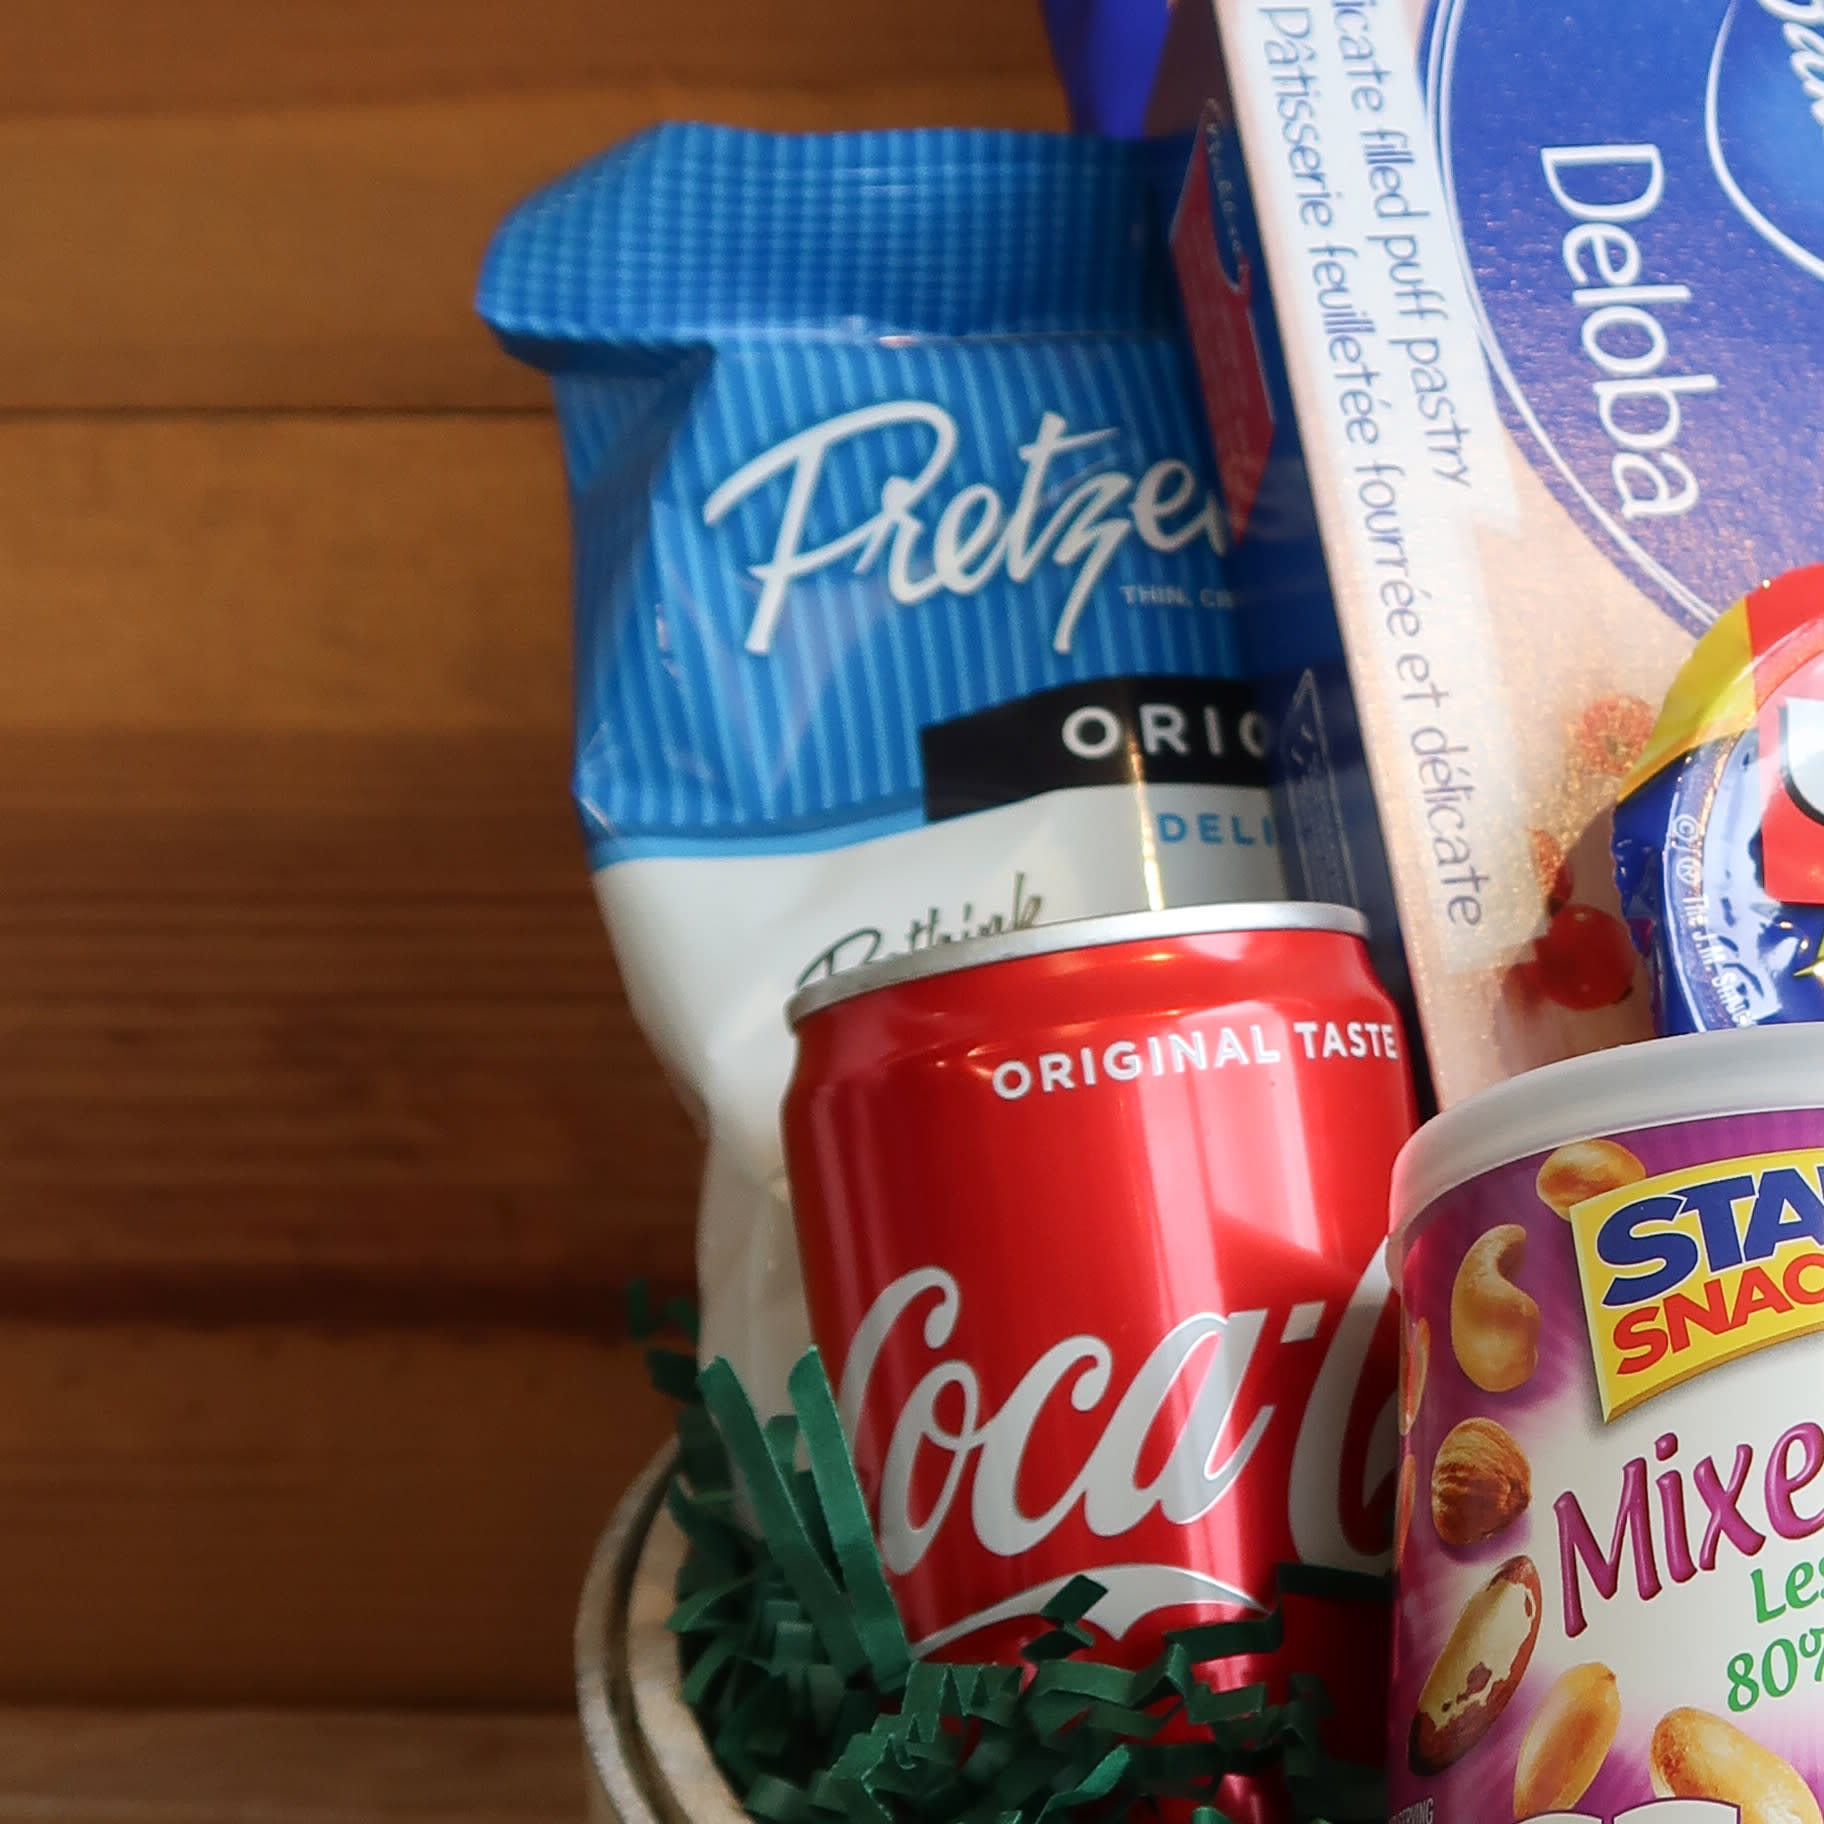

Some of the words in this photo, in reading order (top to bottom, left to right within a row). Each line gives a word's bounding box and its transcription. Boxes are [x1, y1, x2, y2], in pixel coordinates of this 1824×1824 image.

[1258, 5, 1344, 230] Pâtisserie
[1359, 128, 1430, 220] filled
[1366, 234, 1449, 322] puff
[1541, 143, 1719, 520] Deloba
[1387, 335, 1471, 488] pastry
[1395, 652, 1450, 709] et
[1410, 725, 1488, 930] délicate
[992, 1024, 1281, 1100] ORIGINAL
[1294, 1020, 1398, 1062] TASTE
